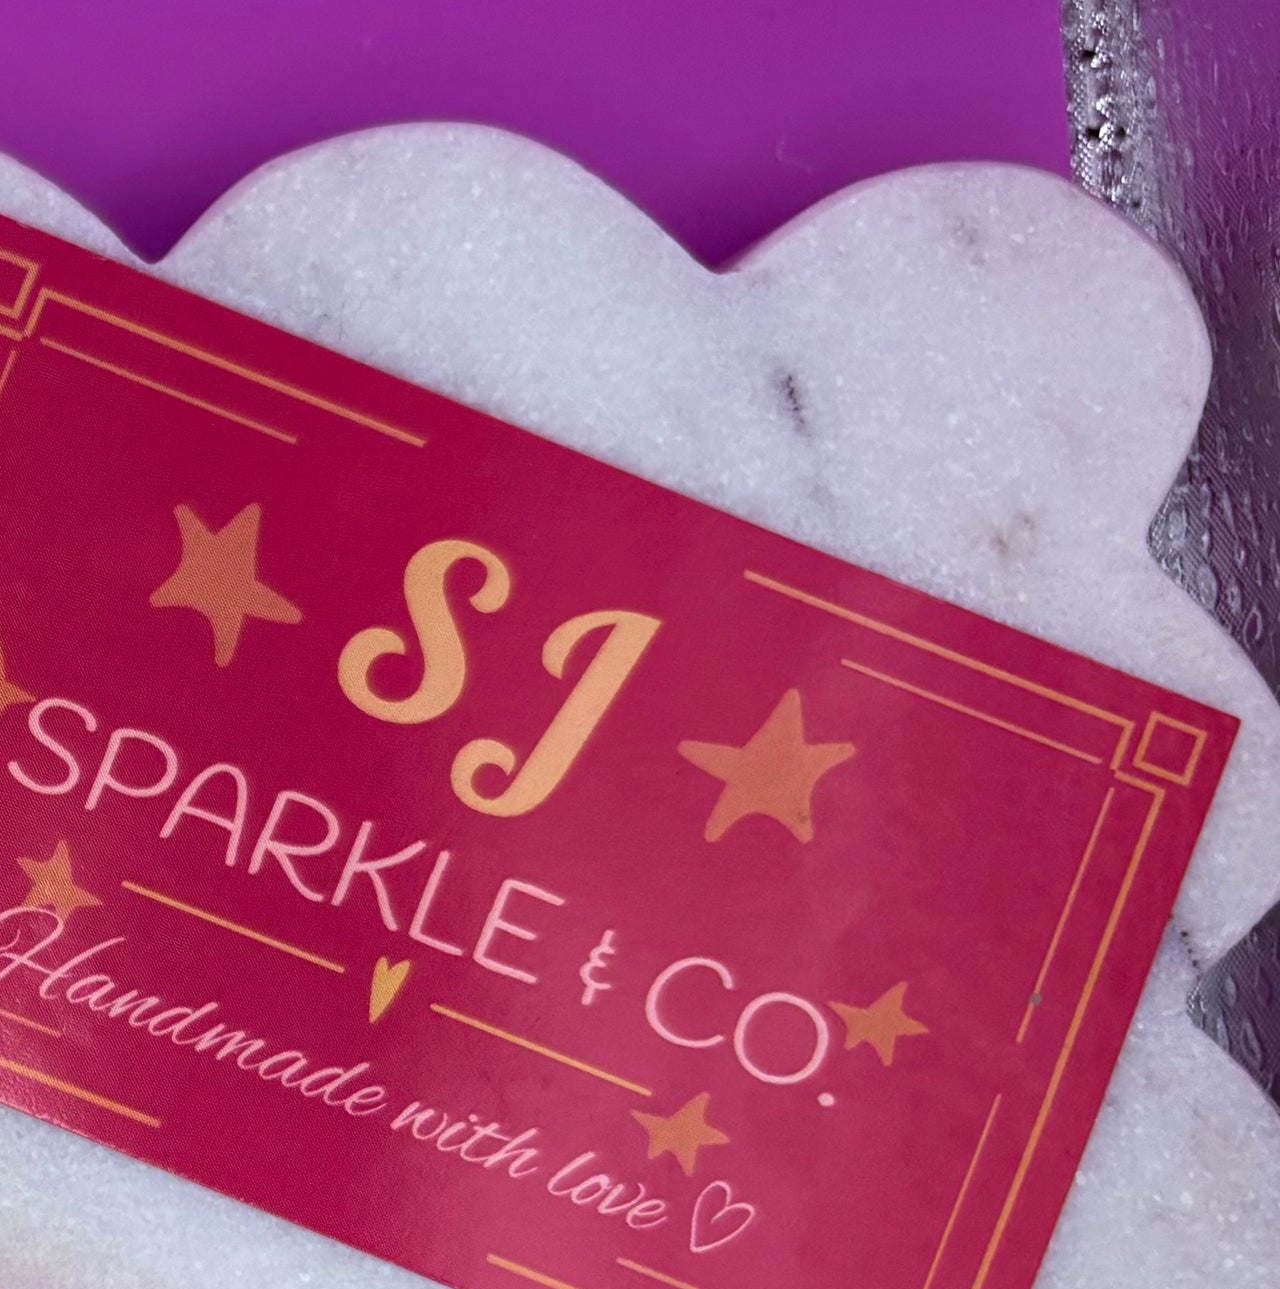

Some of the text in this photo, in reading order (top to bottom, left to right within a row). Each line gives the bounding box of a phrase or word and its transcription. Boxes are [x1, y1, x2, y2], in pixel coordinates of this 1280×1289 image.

[336, 538, 663, 818] SJ
[6, 696, 837, 1109] SPARKLE & CO.
[390, 1100, 540, 1179] with
[546, 1151, 669, 1230] love
